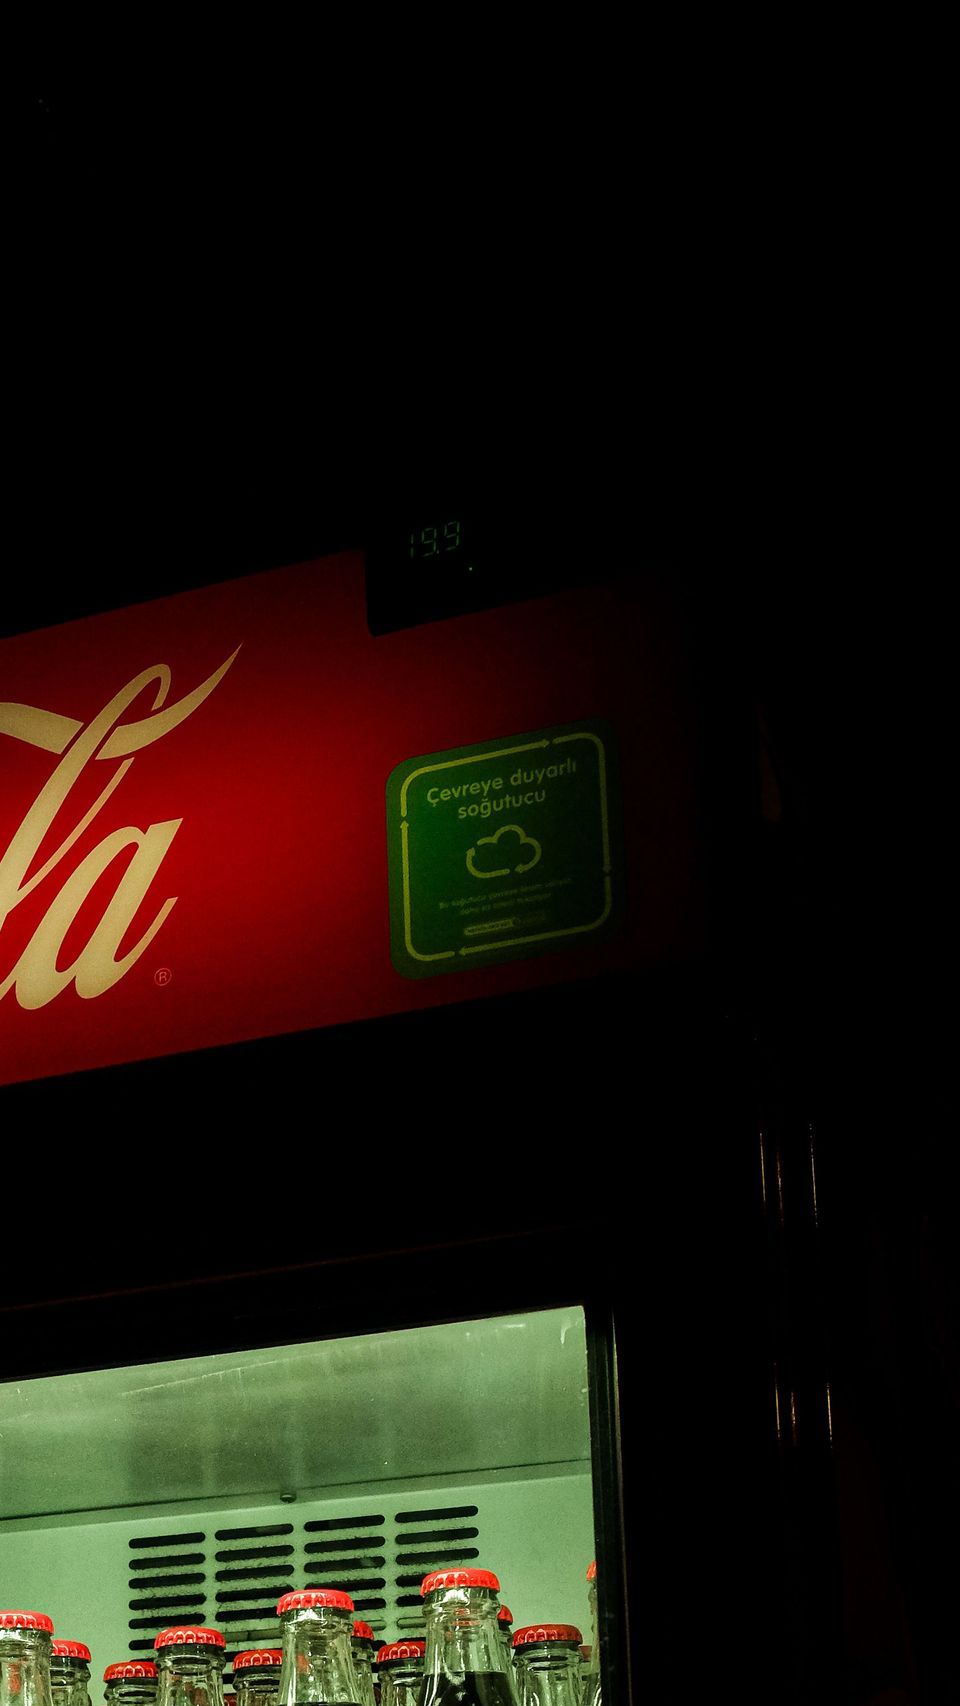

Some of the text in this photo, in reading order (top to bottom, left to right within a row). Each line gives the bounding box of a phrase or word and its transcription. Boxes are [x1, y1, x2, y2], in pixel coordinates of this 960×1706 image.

[427, 757, 577, 807] Çevreye duyarlı
[458, 789, 546, 819] soğutucu
